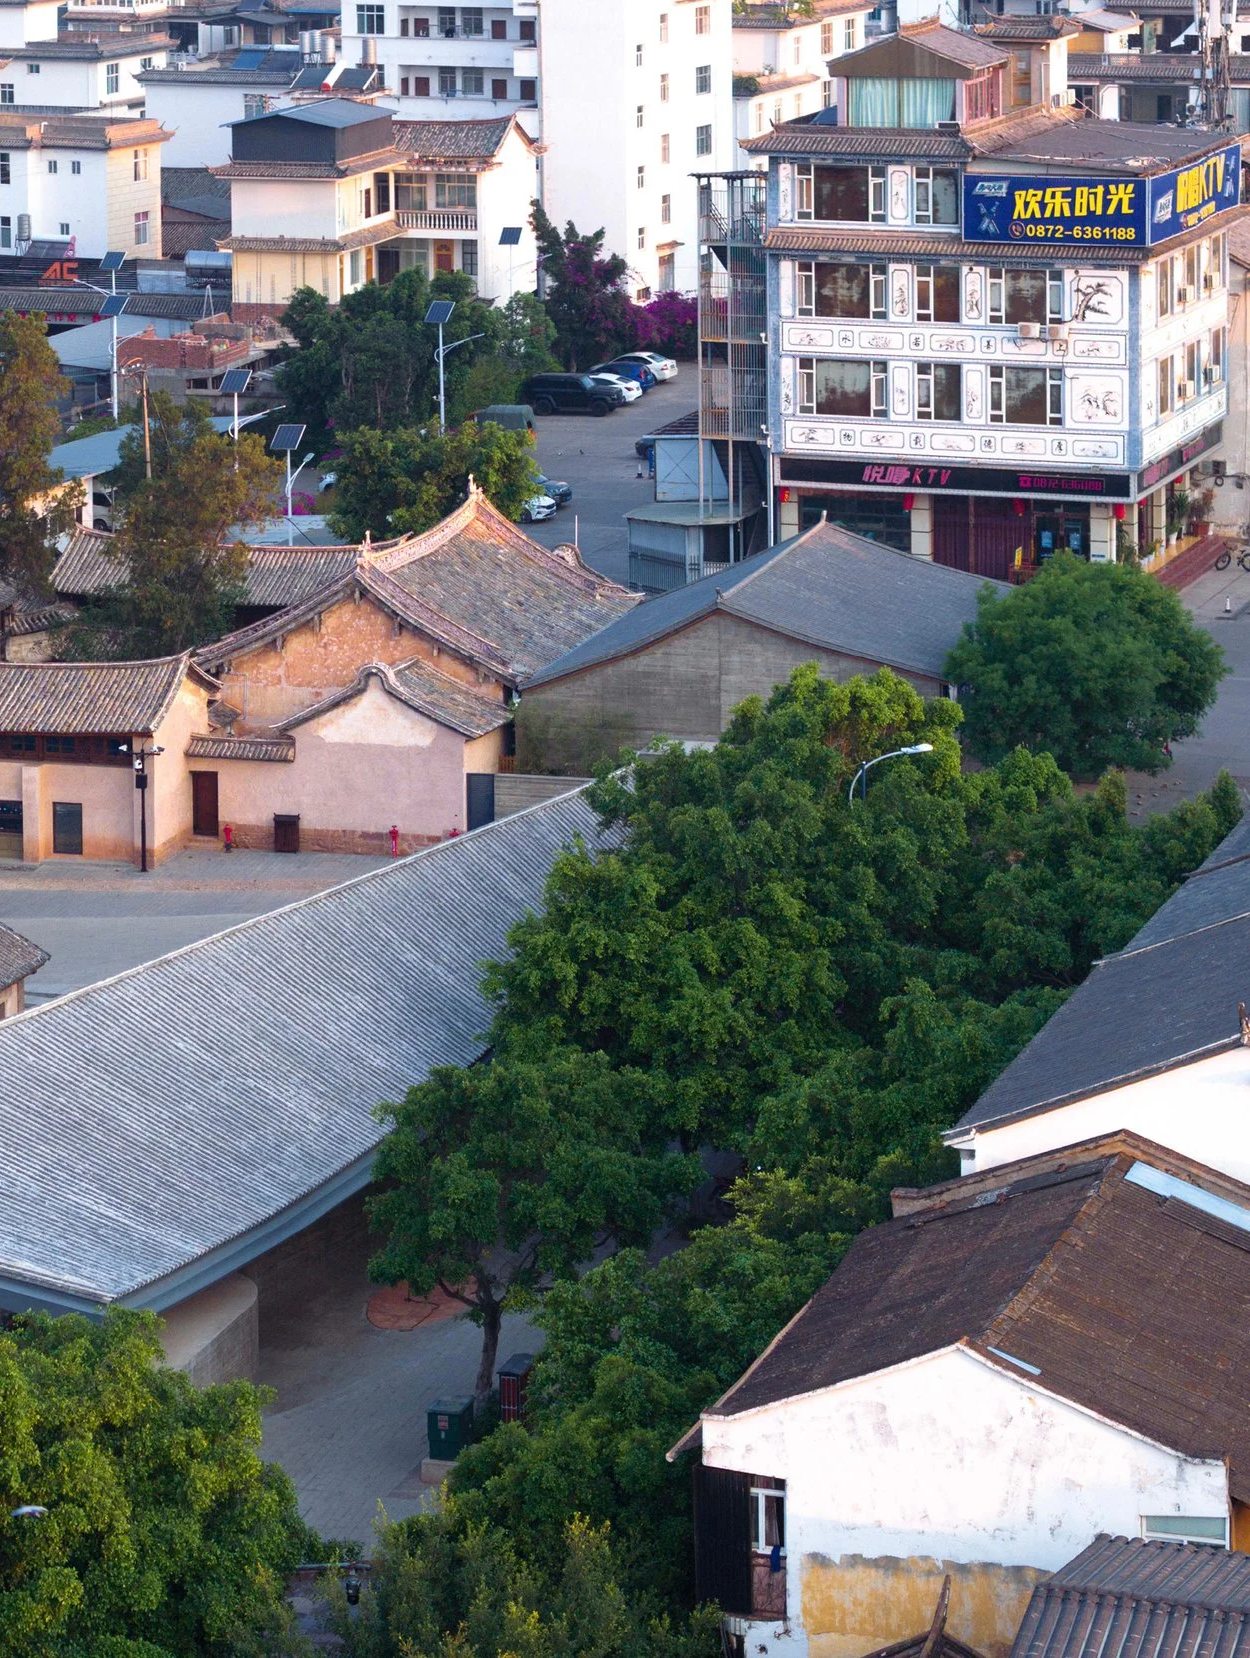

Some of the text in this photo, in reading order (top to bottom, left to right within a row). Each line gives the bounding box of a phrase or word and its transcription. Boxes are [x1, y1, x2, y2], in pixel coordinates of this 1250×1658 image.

[1012, 183, 1135, 220] 欢乐时光
[1026, 224, 1136, 240] 0872-6361188
